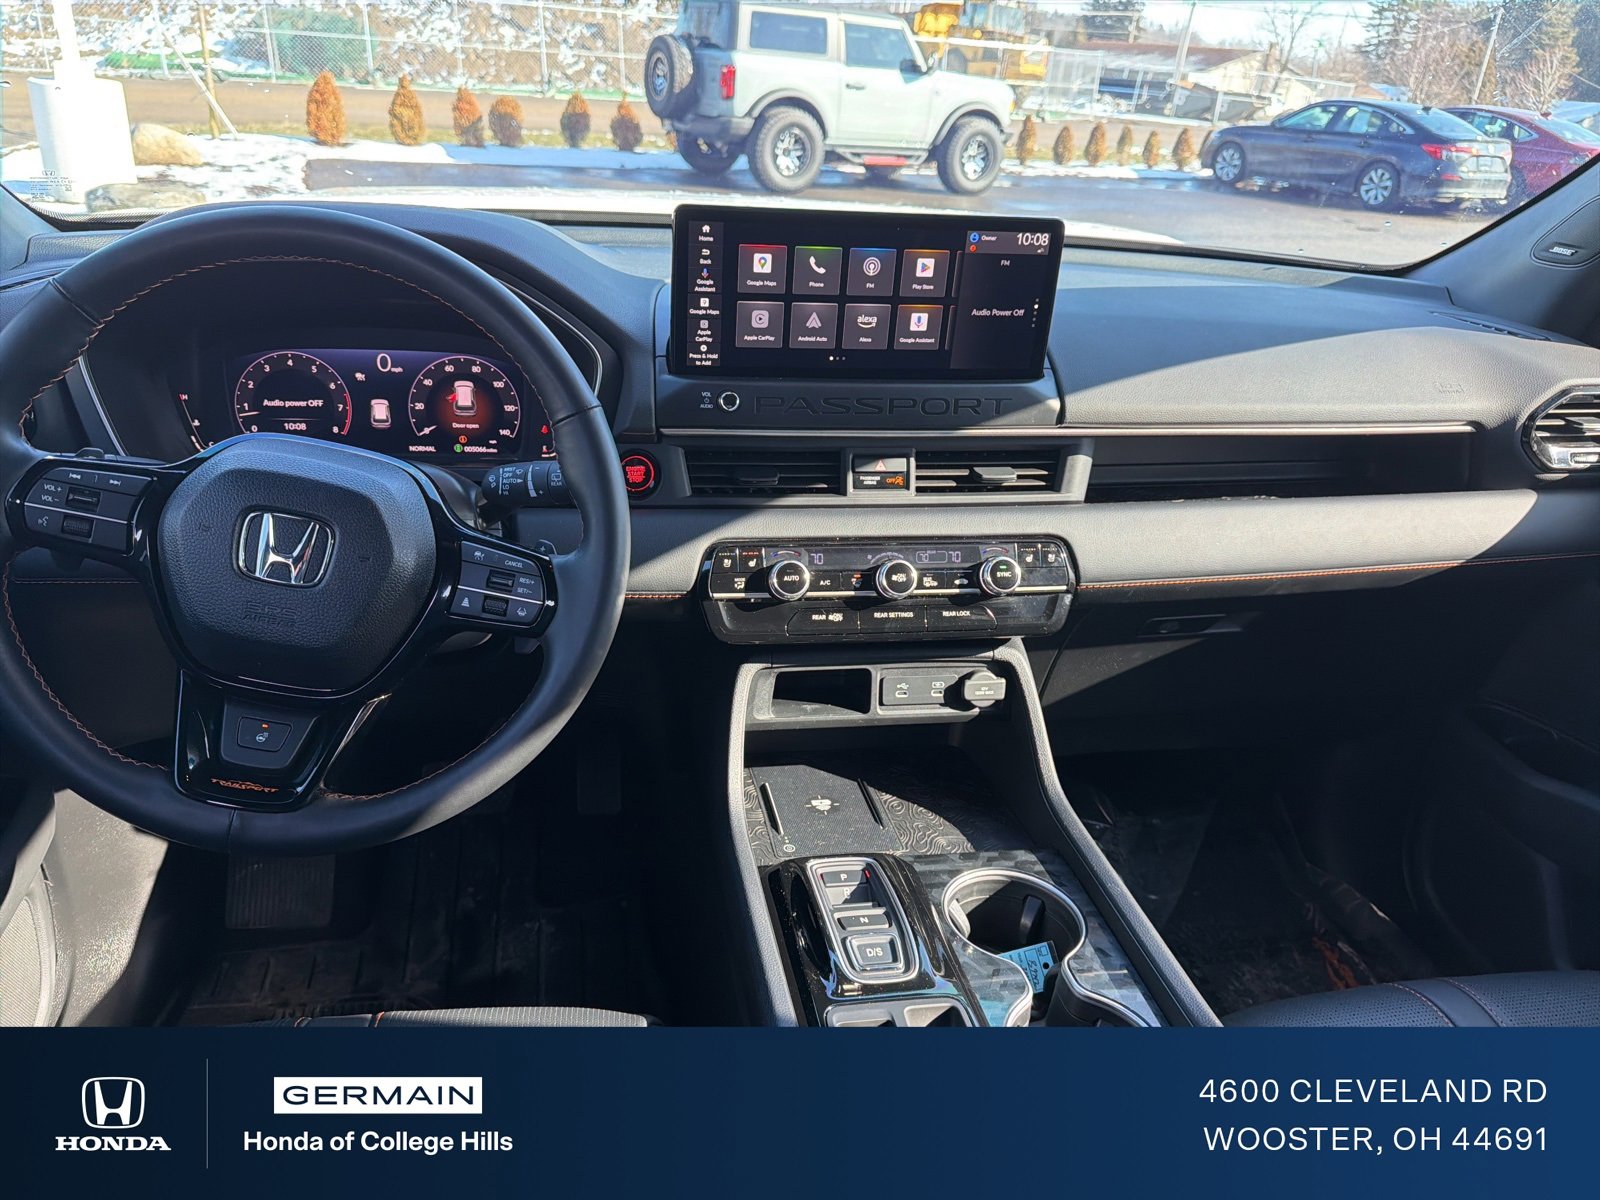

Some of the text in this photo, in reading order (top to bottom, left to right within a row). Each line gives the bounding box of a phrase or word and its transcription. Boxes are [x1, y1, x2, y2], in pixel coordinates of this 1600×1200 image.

[1017, 233, 1049, 245] 10:08
[857, 315, 877, 323] alexa
[377, 353, 391, 372] 0
[338, 404, 343, 412] 7
[754, 397, 1013, 416] PASSPORT
[332, 426, 339, 434] 8
[44, 483, 56, 491] VOL
[810, 554, 824, 564] 70
[949, 551, 961, 562] 70
[504, 560, 523, 568] CANCEL
[866, 948, 883, 957] D/S
